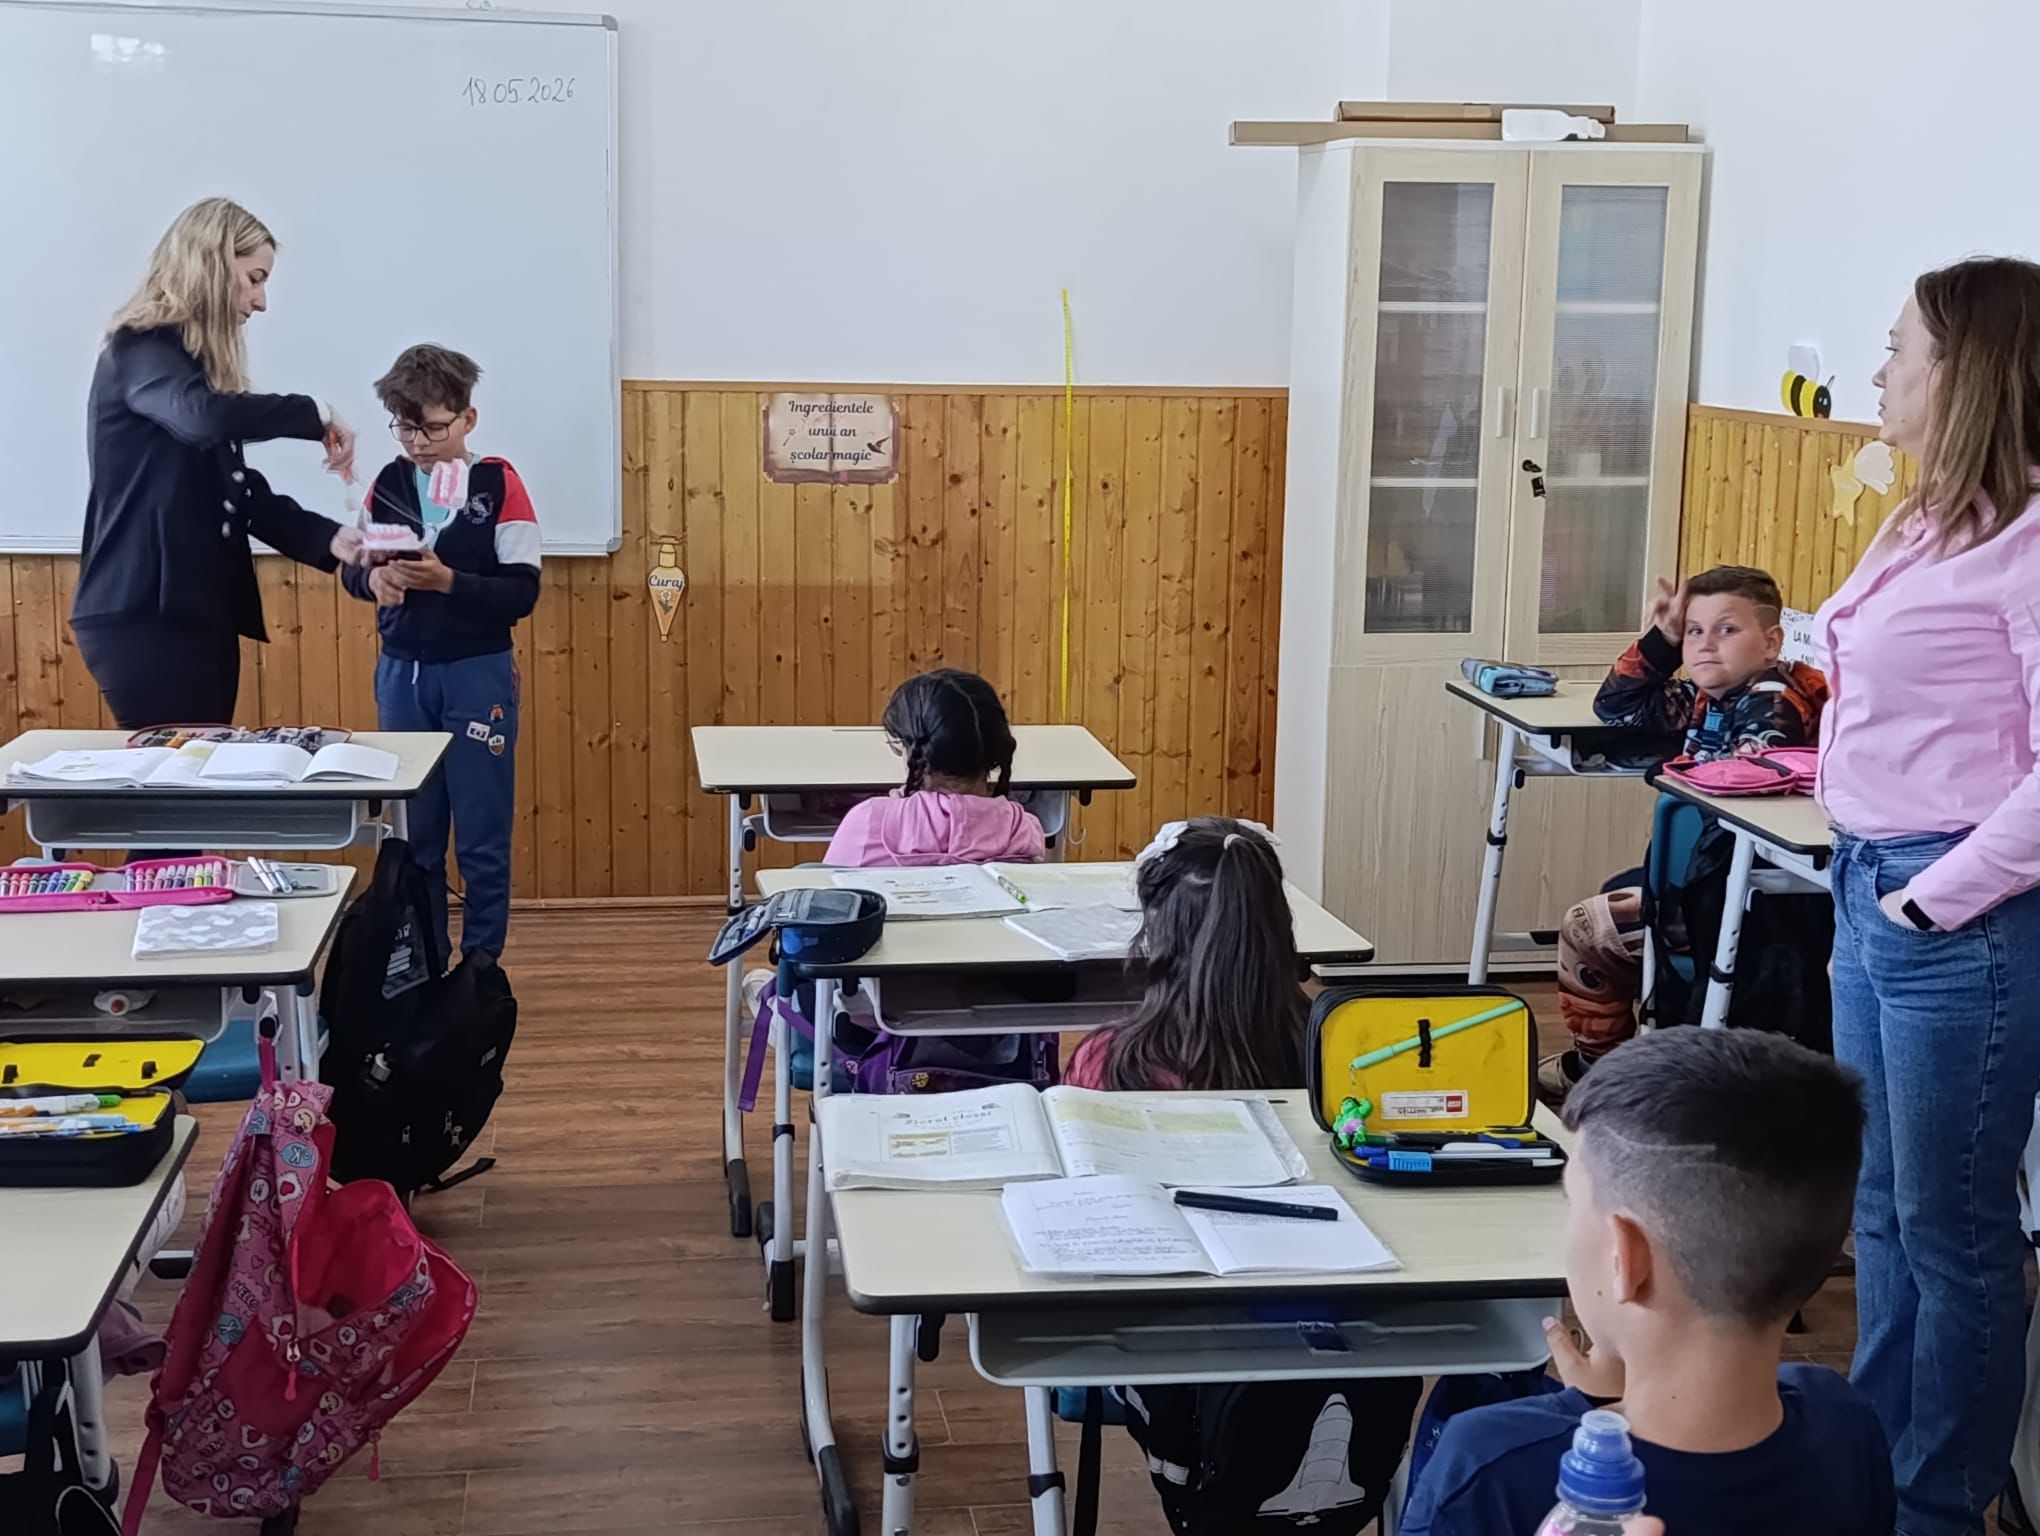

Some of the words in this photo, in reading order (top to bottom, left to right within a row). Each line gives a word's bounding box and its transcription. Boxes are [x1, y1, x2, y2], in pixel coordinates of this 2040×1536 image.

[788, 400, 874, 418] Ingredientele
[808, 426, 837, 437] unui
[839, 427, 857, 437] an
[832, 449, 872, 465] magic
[648, 575, 683, 592] Curaj
